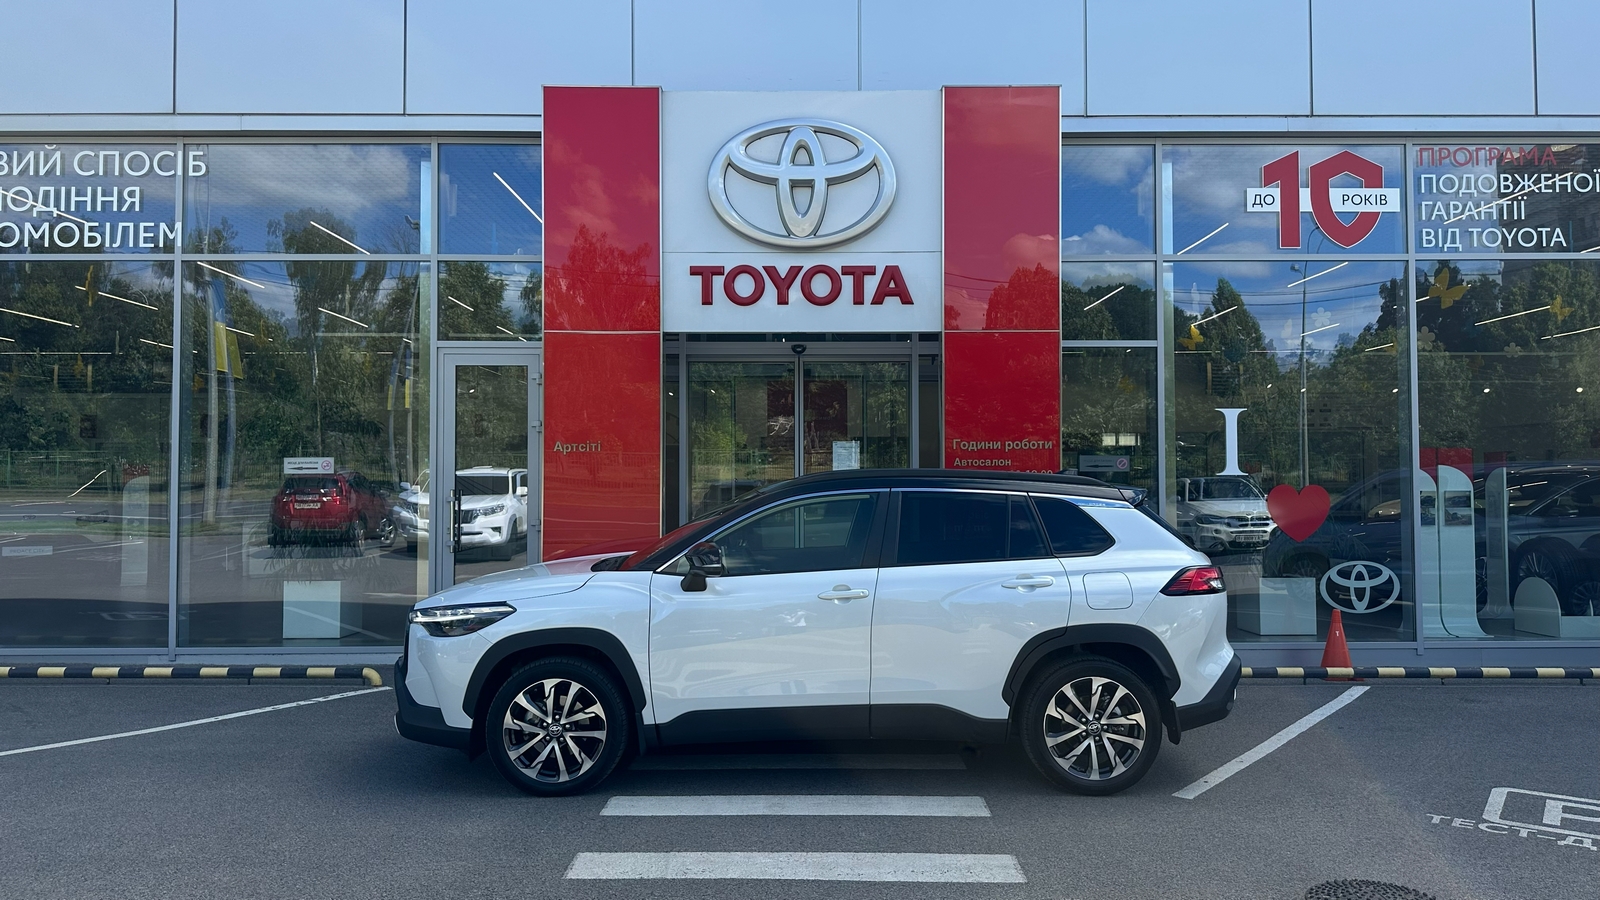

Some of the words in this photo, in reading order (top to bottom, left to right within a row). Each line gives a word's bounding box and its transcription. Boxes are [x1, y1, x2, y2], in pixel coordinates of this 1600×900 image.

[73, 150, 207, 177] СПОСІБ
[1418, 146, 1557, 167] ПРОГРАМА
[1420, 168, 1600, 197] ПОДОВЖЕНОЇ
[0, 185, 140, 217] ОДІННЯ
[1252, 193, 1276, 208] ДО
[1262, 149, 1385, 249] 10
[1341, 193, 1388, 206] РОКІВ
[1421, 196, 1528, 221] ГАРАНТІЇ
[0, 221, 182, 248] ОМОБІЛЕМ
[1422, 228, 1463, 252] ВІД
[1468, 227, 1567, 248] TOYOTA
[689, 264, 915, 307] TOYOTA
[553, 440, 601, 455] Артсіті
[953, 438, 1001, 451] Години
[1005, 438, 1053, 452] роботи
[1214, 408, 1249, 476] I
[953, 457, 1012, 467] Автосалон
